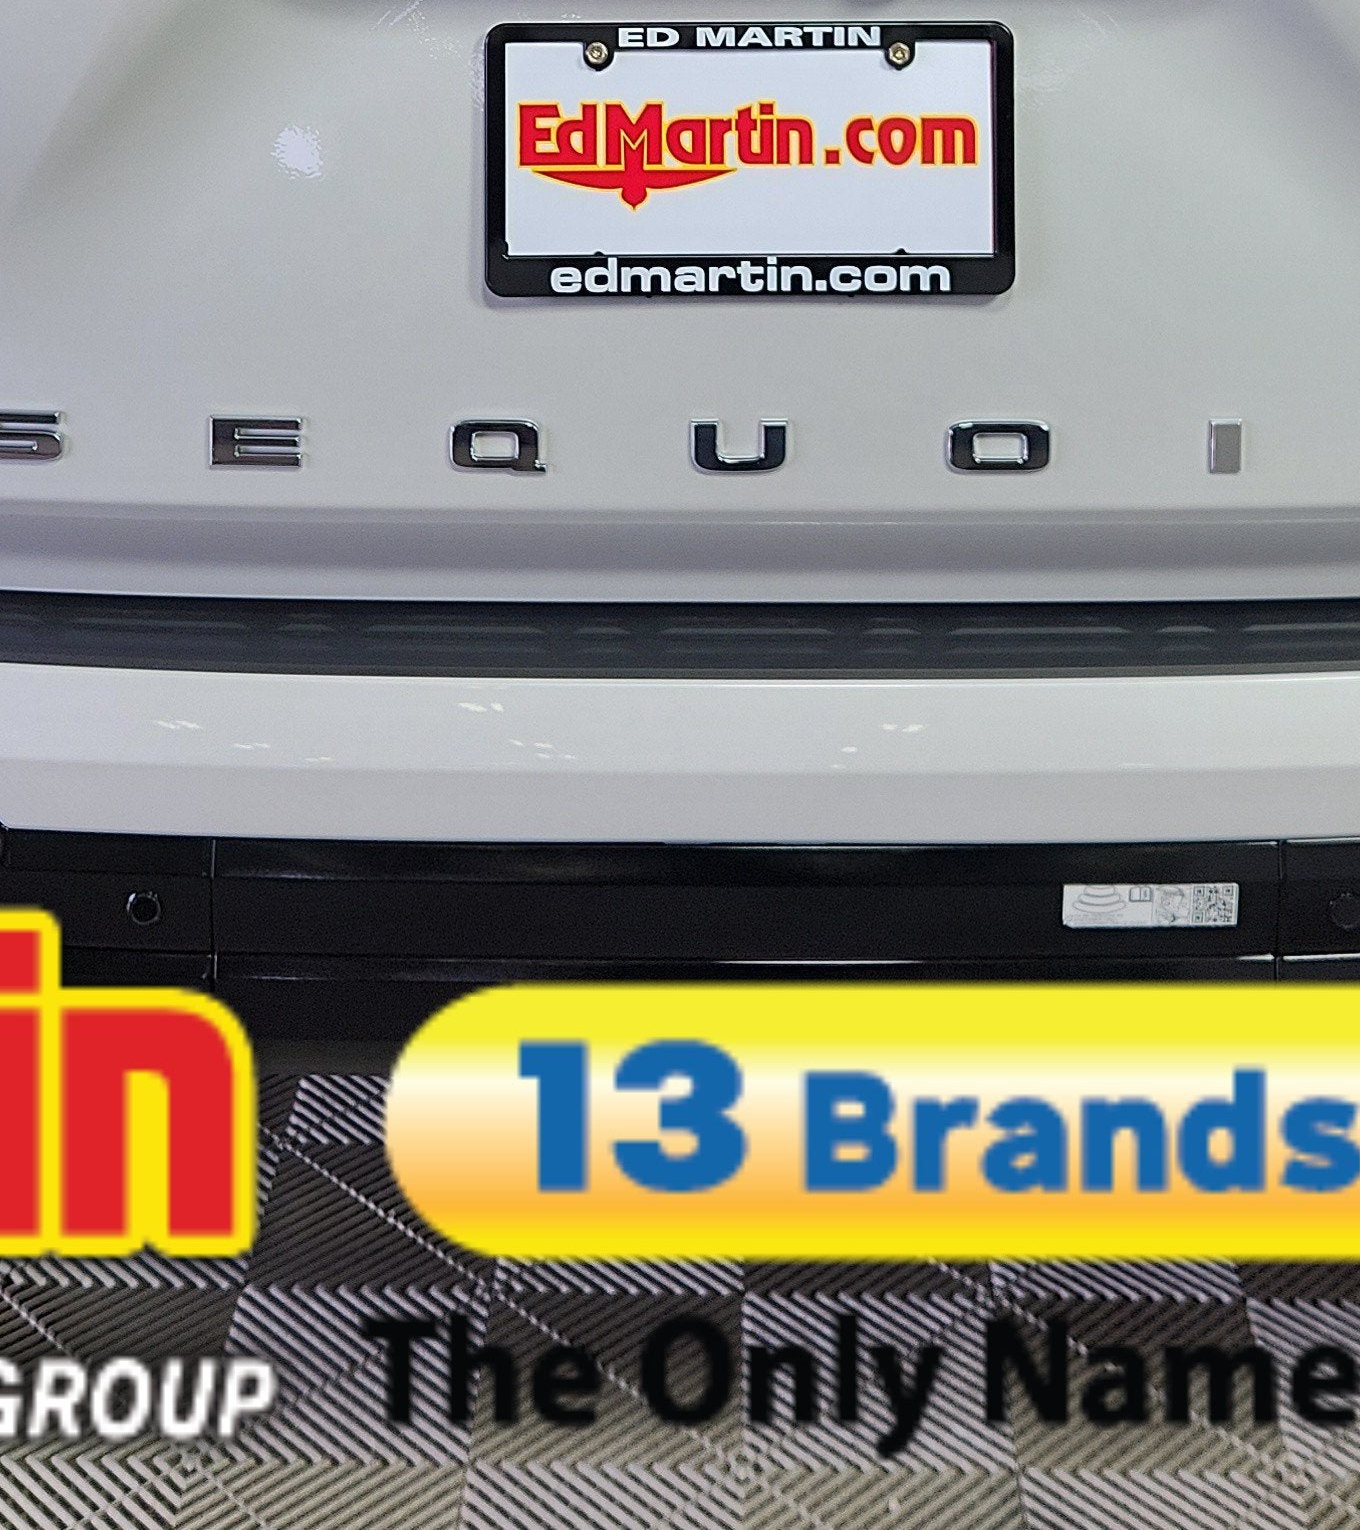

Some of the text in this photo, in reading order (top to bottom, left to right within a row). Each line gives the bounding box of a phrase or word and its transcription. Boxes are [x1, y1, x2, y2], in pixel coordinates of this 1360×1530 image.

[617, 26, 882, 47] ED MARTIN
[550, 256, 952, 295] edmartin.com
